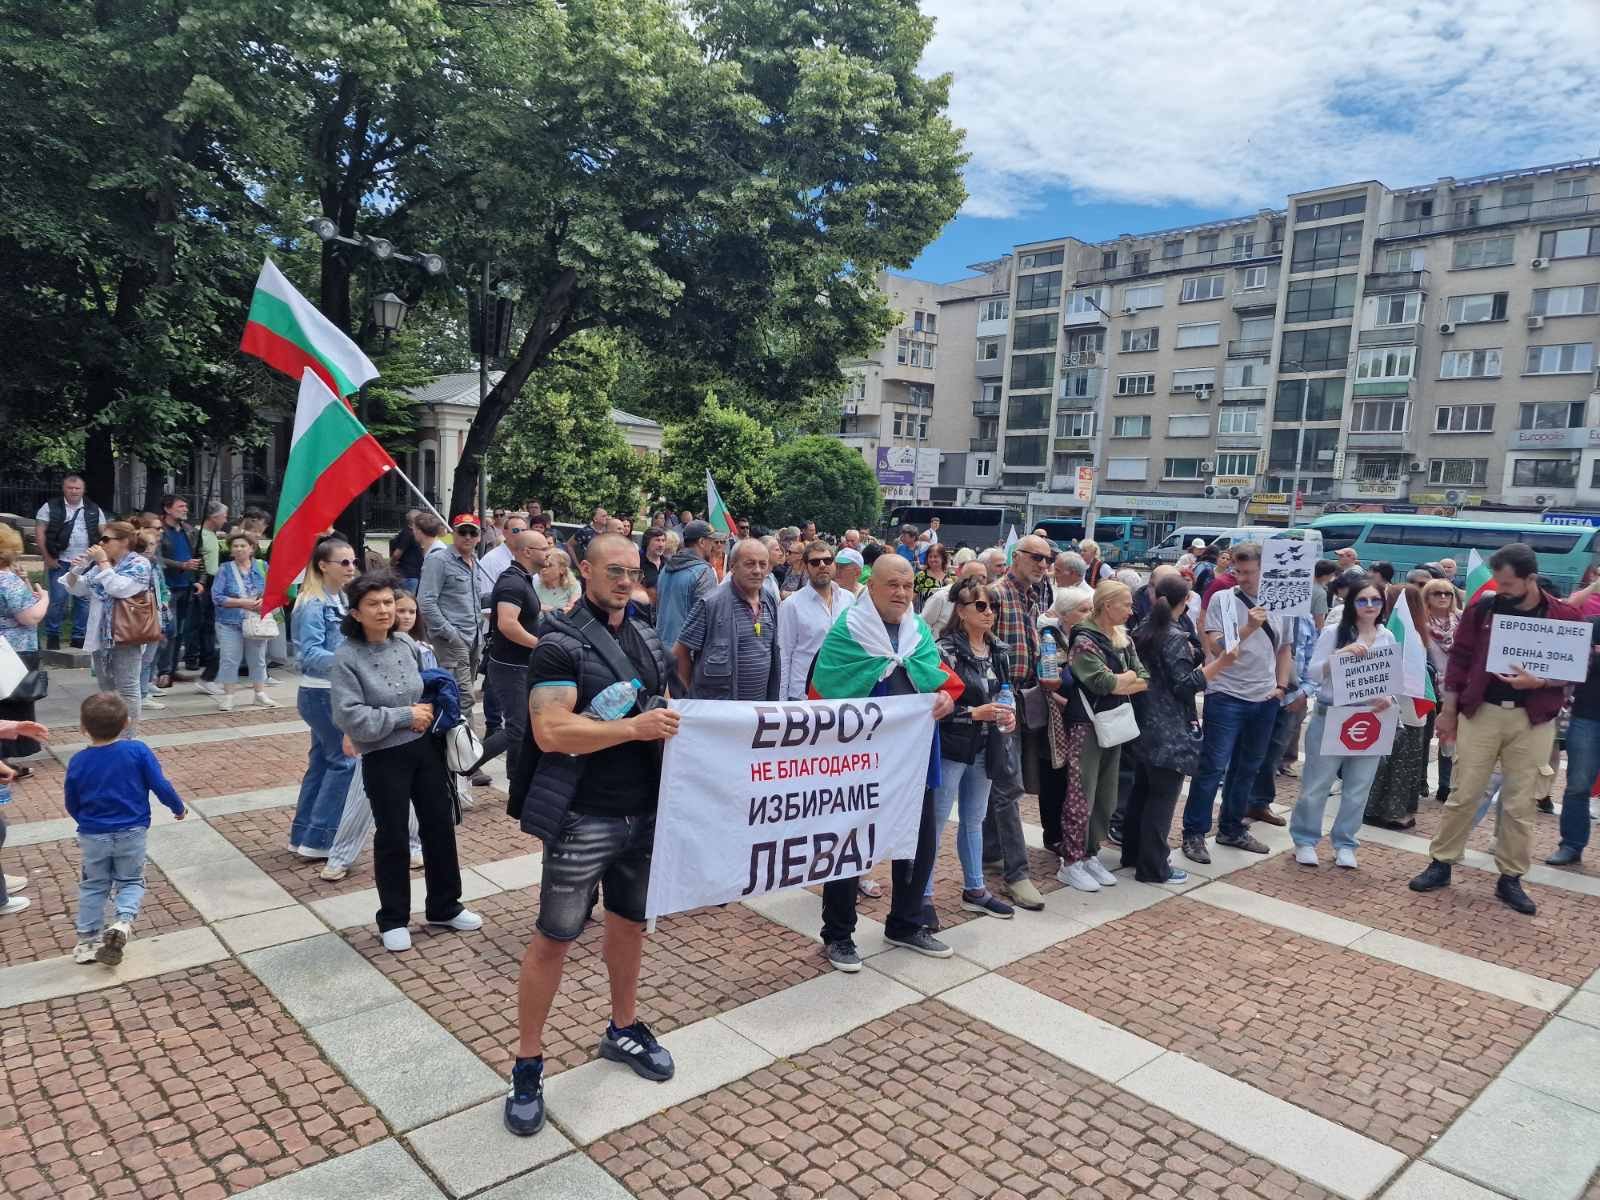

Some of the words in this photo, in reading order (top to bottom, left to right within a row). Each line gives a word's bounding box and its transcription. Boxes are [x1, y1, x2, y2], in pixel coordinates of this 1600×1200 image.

[1499, 620, 1554, 634] ЕВРОЗОНА
[1557, 625, 1586, 637] ДНЕС
[1502, 646, 1543, 659] ВОЕННА
[1546, 650, 1575, 662] ЗОНА
[1345, 660, 1391, 677] ДИКТАТУРА
[1346, 679, 1357, 689] НЕ
[1358, 672, 1390, 686] ВЪВЕДЕ
[1349, 686, 1387, 701] РУБЛАТА!
[751, 702, 884, 749] ЕВРО?
[777, 753, 871, 779] БЛАГОДАРЯ
[748, 782, 880, 826] ИЗБИРАМЕ
[741, 822, 876, 896] ЛЕВА!
